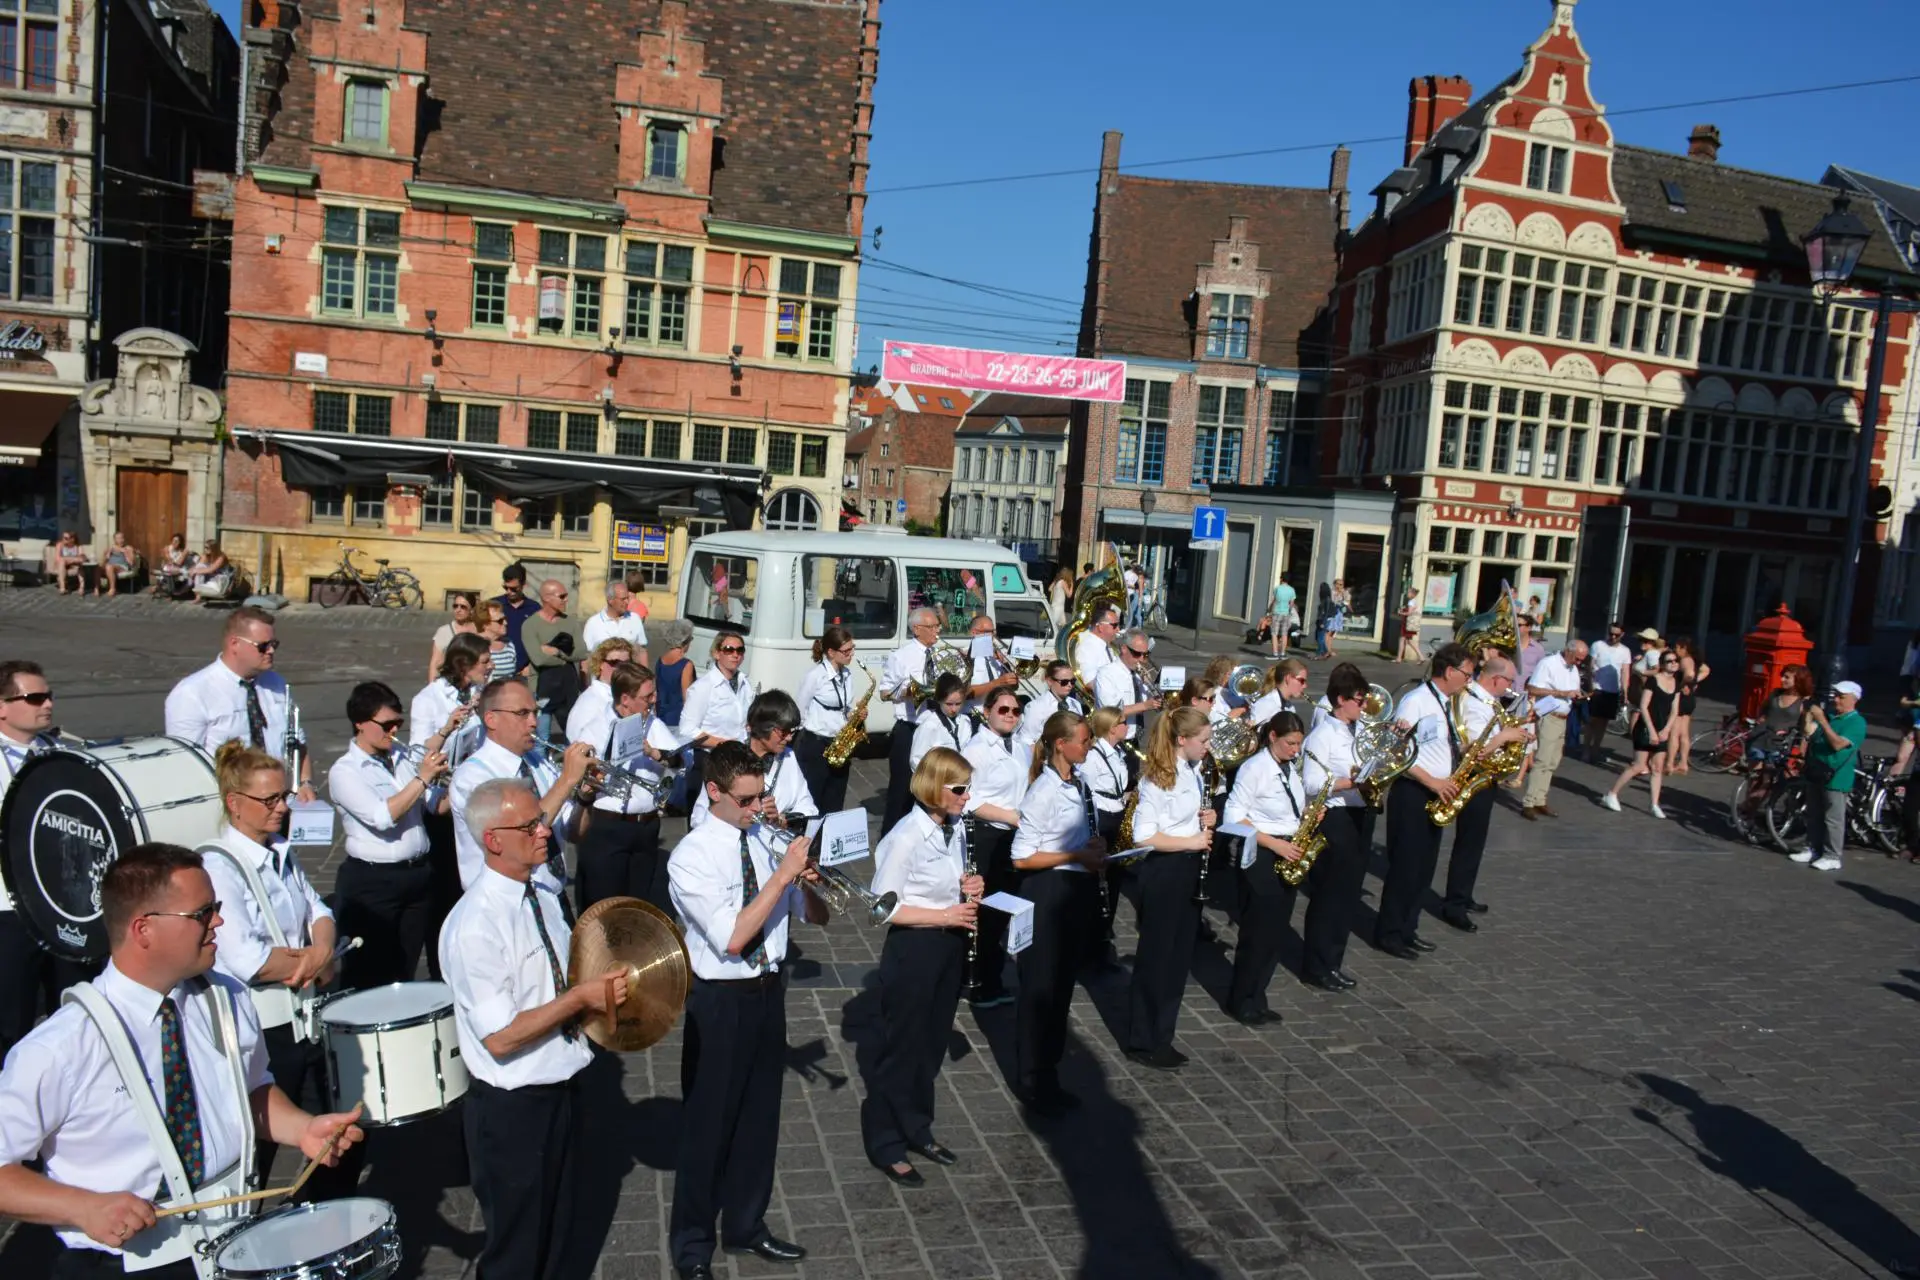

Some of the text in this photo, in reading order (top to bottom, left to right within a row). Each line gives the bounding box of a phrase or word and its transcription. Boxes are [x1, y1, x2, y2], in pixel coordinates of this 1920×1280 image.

[910, 363, 948, 377] BRADERIE
[986, 363, 1076, 388] 22-23-24-25
[1078, 369, 1111, 391] JUNI
[41, 813, 105, 845] AMICITIA
